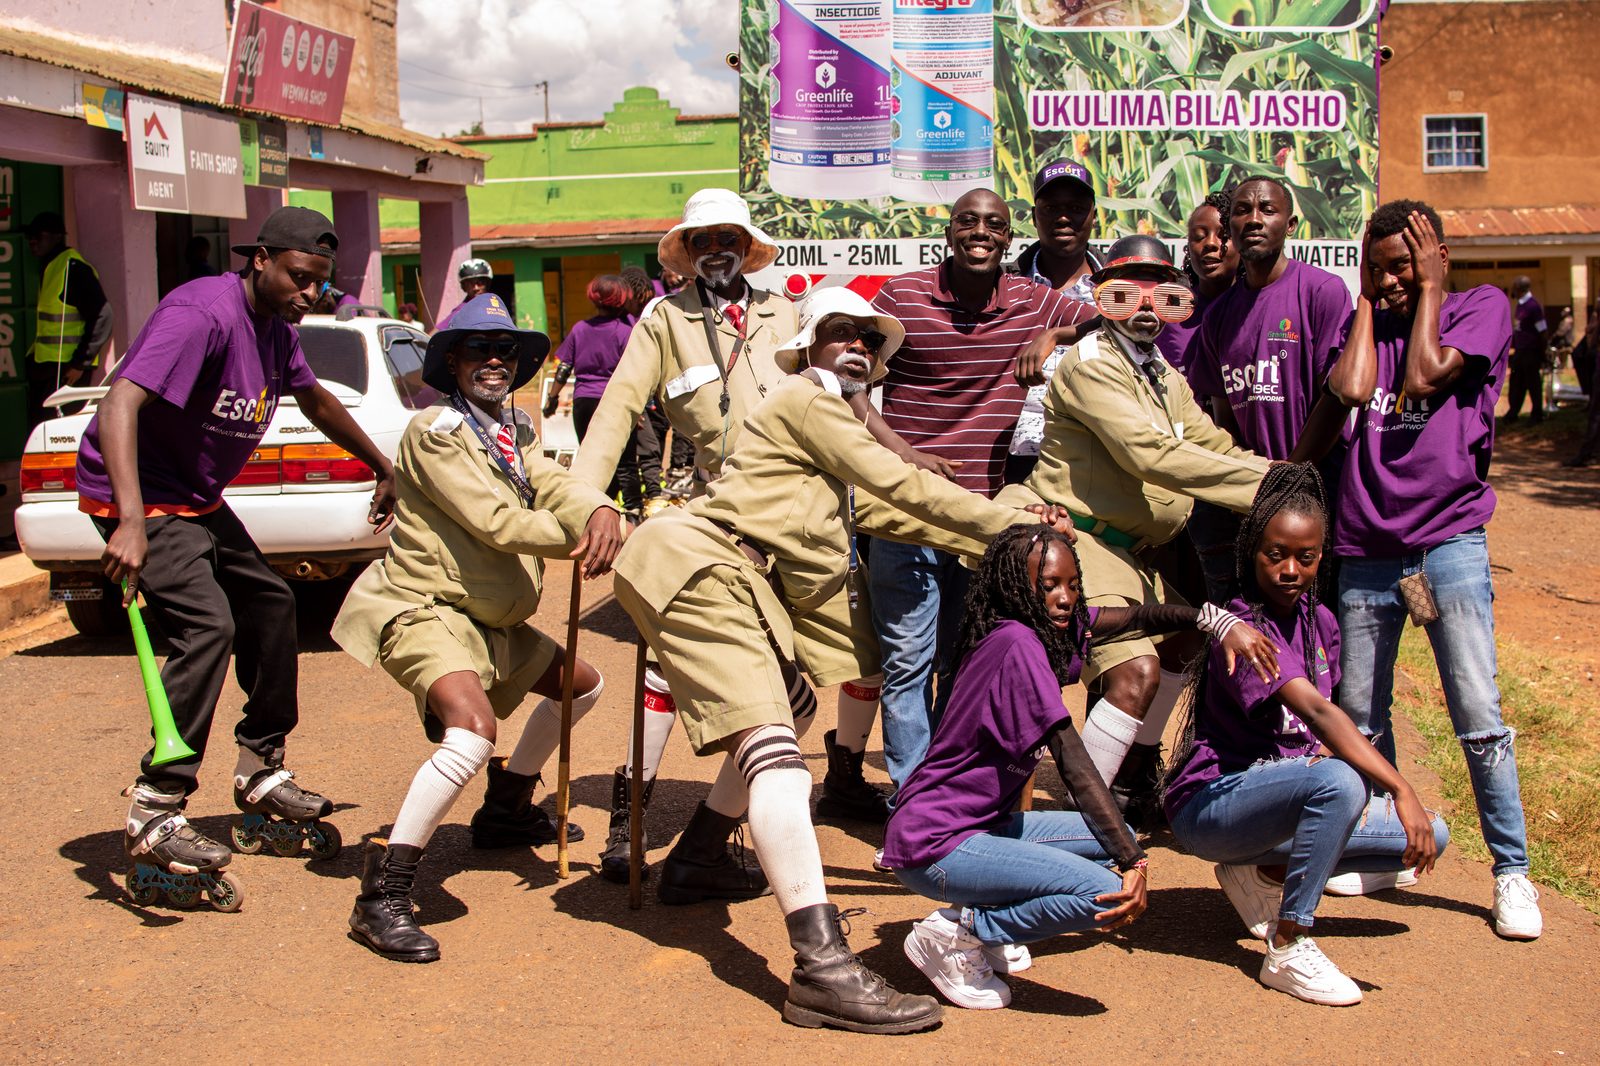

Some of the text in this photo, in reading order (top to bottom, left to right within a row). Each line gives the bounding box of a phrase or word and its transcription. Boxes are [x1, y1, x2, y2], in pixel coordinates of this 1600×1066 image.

[816, 7, 880, 17] INSECTICIDE
[935, 71, 982, 79] ADJUVANT
[309, 89, 327, 106] SHOP
[796, 88, 853, 102] Greenlife
[1032, 95, 1341, 127] UKULIMA BILA JASHO
[916, 129, 965, 138] Greenlife
[144, 141, 170, 158] EQUITY
[189, 150, 214, 173] FAITH
[215, 156, 238, 175] SHOP
[148, 181, 174, 198] AGENT
[774, 245, 828, 266] 20ML
[848, 245, 903, 265] 25ML
[1291, 245, 1358, 267] WATER
[1267, 331, 1299, 340] Greenlife
[50, 436, 76, 444] TOYOTA
[481, 432, 503, 459] JUNCTION
[512, 475, 534, 498] JUNCTION
